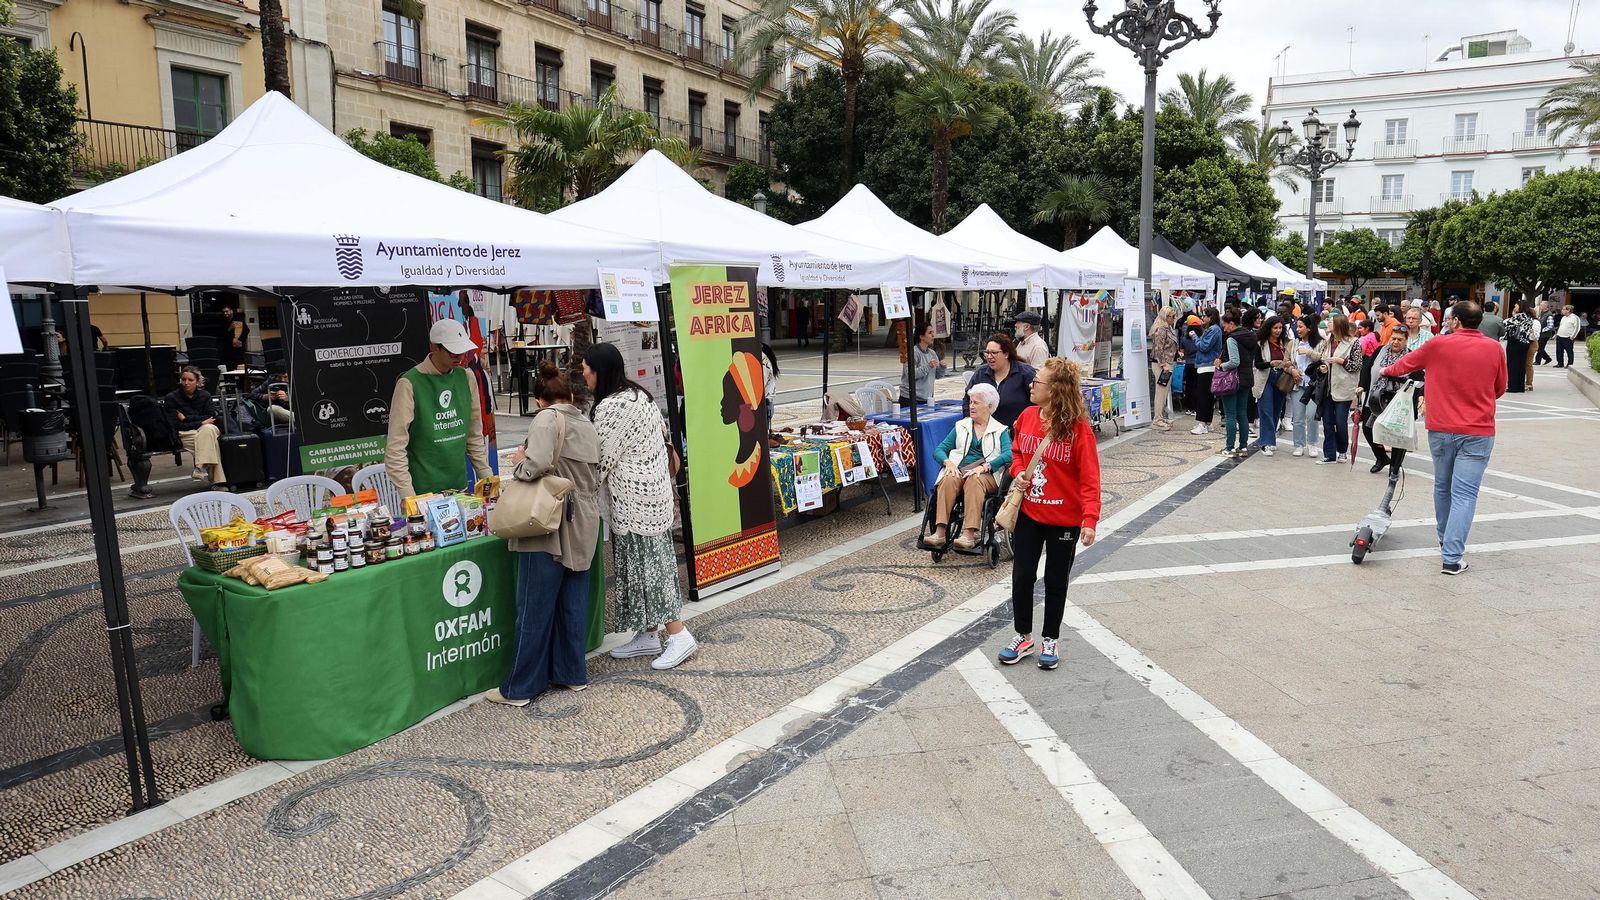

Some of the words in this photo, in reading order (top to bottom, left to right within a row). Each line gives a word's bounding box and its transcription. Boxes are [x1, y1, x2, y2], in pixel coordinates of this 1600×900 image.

[376, 241, 471, 260] Ayuntamiento
[471, 244, 488, 257] de
[491, 245, 521, 261] Jerez
[400, 265, 443, 278] Igualdad
[446, 268, 451, 278] y
[455, 265, 506, 276] Diversidad
[788, 260, 830, 271] Ayuntamiento
[830, 261, 838, 270] de
[838, 262, 853, 272] Jerez
[799, 274, 819, 282] Igualdad
[823, 274, 846, 282] Diversidad
[692, 285, 746, 305] JEREZ
[689, 314, 754, 336] AFRICA
[316, 346, 364, 360] COMERCIO
[366, 343, 399, 355] JUSTO
[435, 408, 457, 420] OXFAM
[433, 418, 464, 431] Intermón
[308, 445, 356, 457] CAMBIAMOS
[356, 441, 378, 450] VIDAS
[310, 455, 327, 465] QUE
[328, 451, 363, 462] CAMBIAN
[363, 447, 385, 457] VIDAS
[434, 607, 492, 642] OXFAM
[427, 632, 500, 671] Intermón
